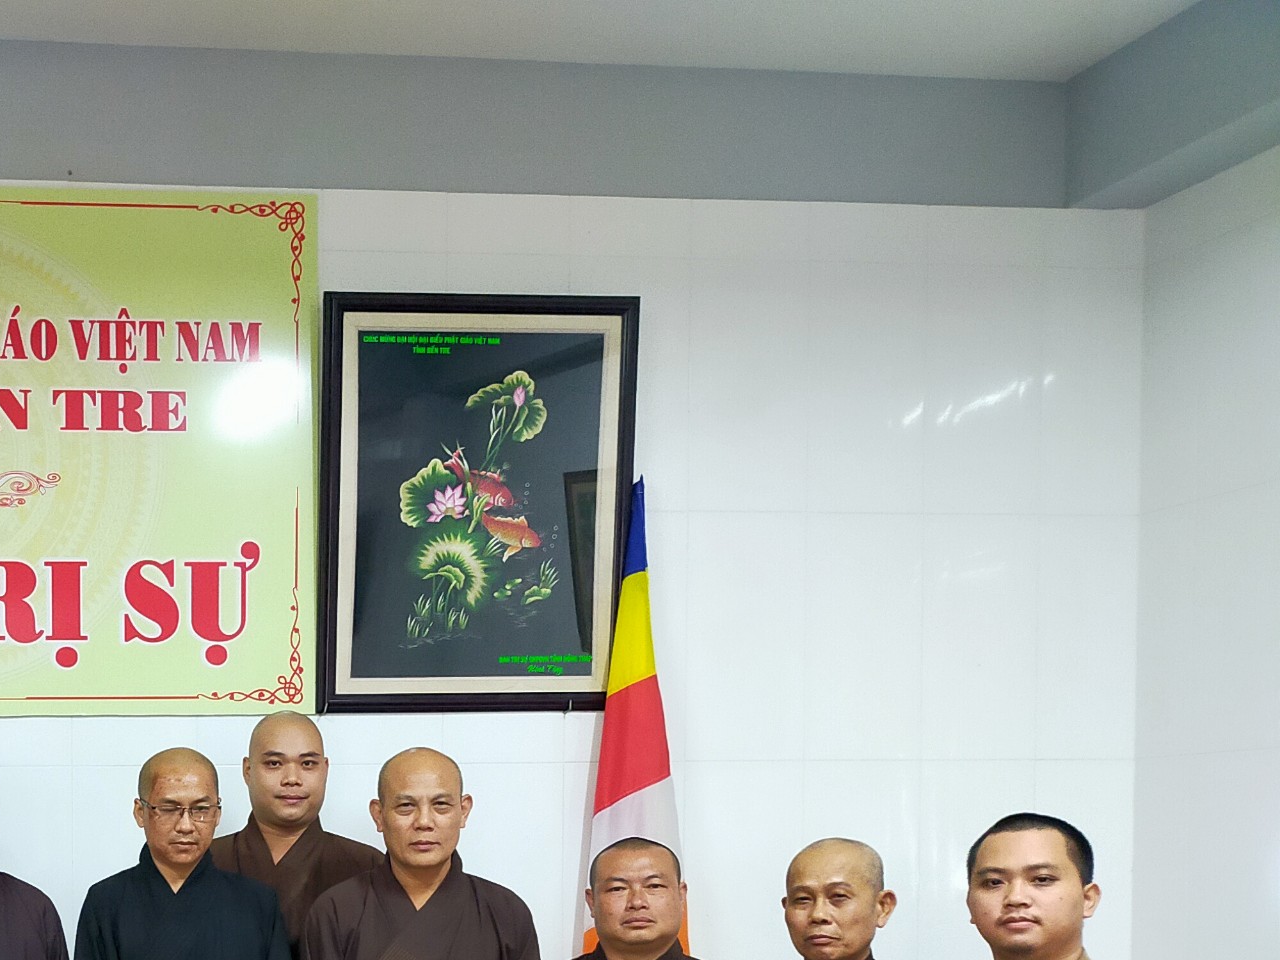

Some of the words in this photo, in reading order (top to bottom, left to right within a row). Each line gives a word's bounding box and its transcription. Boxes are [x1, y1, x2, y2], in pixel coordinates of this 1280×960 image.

[68, 308, 165, 374] VIỆT
[176, 321, 262, 362] NAM
[53, 389, 187, 432] TRE
[123, 541, 261, 667] SỰ
